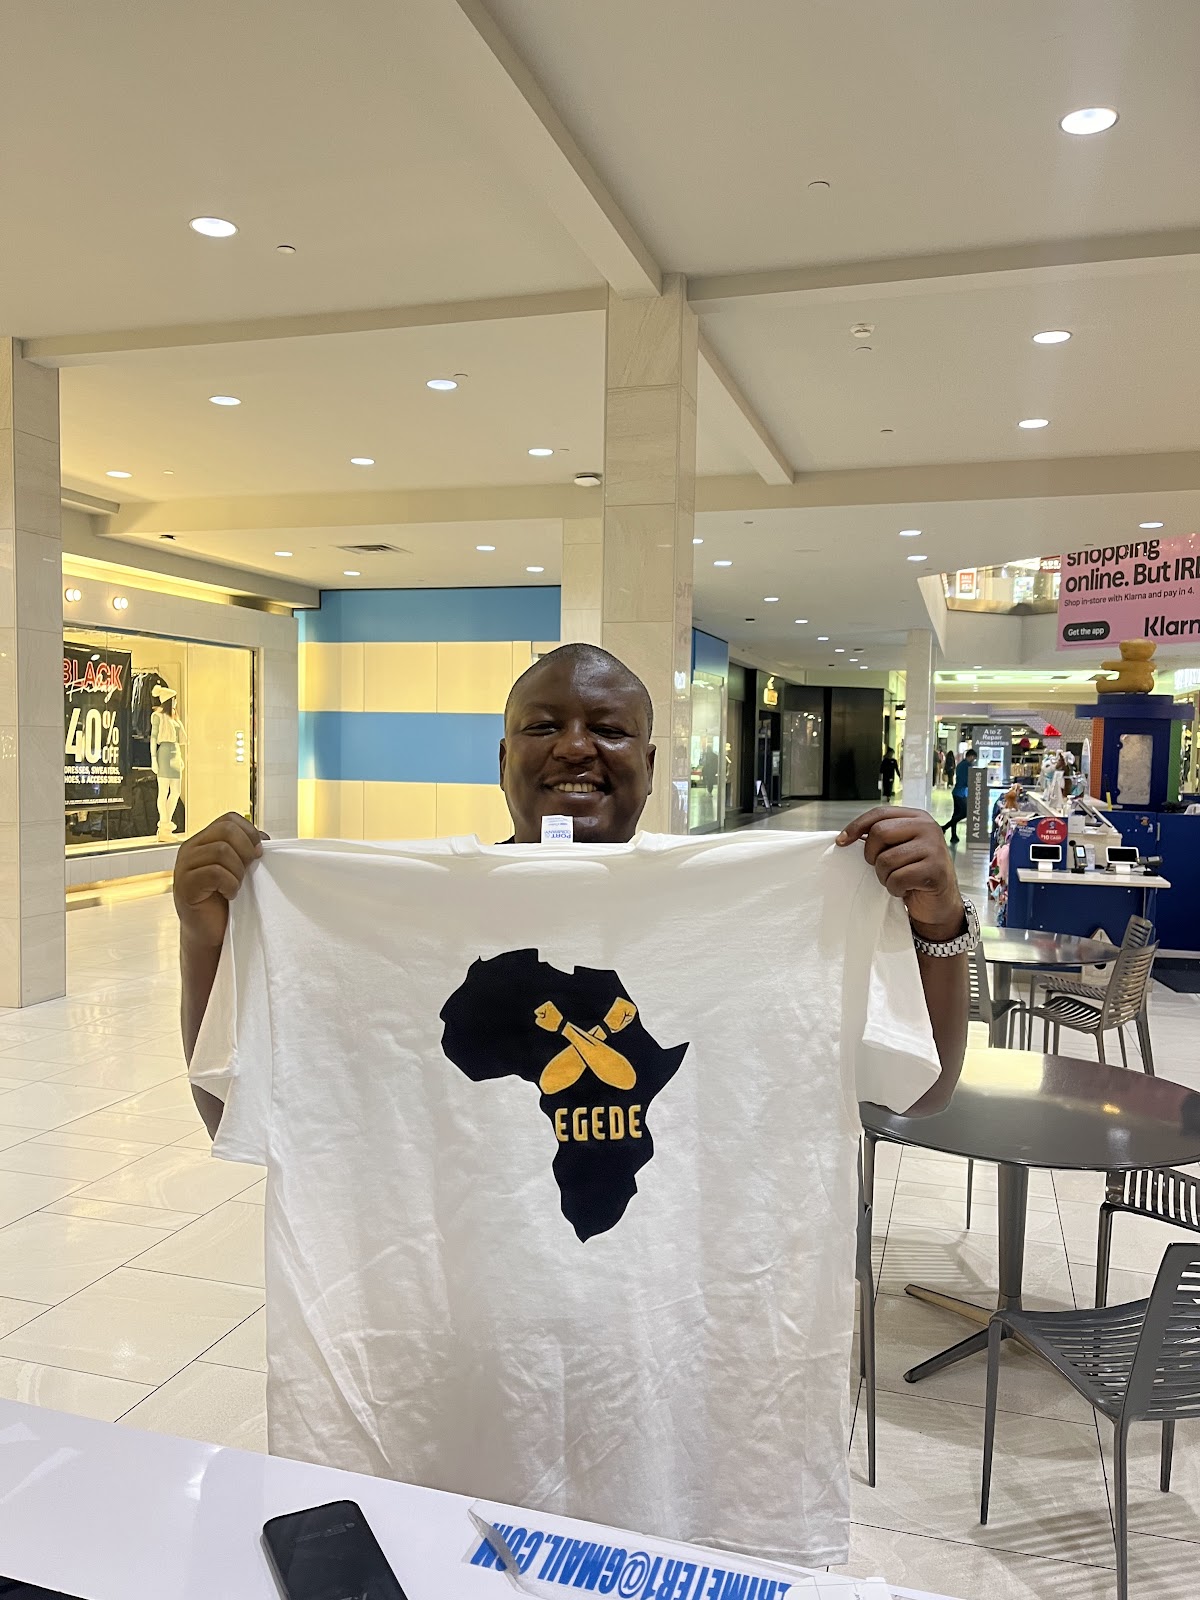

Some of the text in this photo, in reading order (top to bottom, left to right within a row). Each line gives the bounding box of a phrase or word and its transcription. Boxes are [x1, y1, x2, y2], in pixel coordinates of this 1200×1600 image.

[1065, 567, 1129, 592] online.
[1133, 561, 1171, 585] But
[1064, 599, 1080, 607] Shop
[1081, 597, 1106, 605] in-store
[1108, 594, 1123, 603] with
[1124, 592, 1147, 601] Klarna
[1148, 590, 1162, 598] and
[1163, 590, 1177, 598] pay
[1179, 587, 1186, 595] in
[1068, 627, 1105, 636] Get the app
[63, 658, 123, 691] BLACK
[65, 675, 118, 703] Friday
[65, 707, 119, 763] 40%
[102, 746, 120, 763] OFF
[64, 775, 81, 784] HOES,
[972, 772, 982, 815] Accesories
[972, 822, 980, 831] to
[972, 831, 980, 839] A
[555, 1104, 642, 1142] EGEDE
